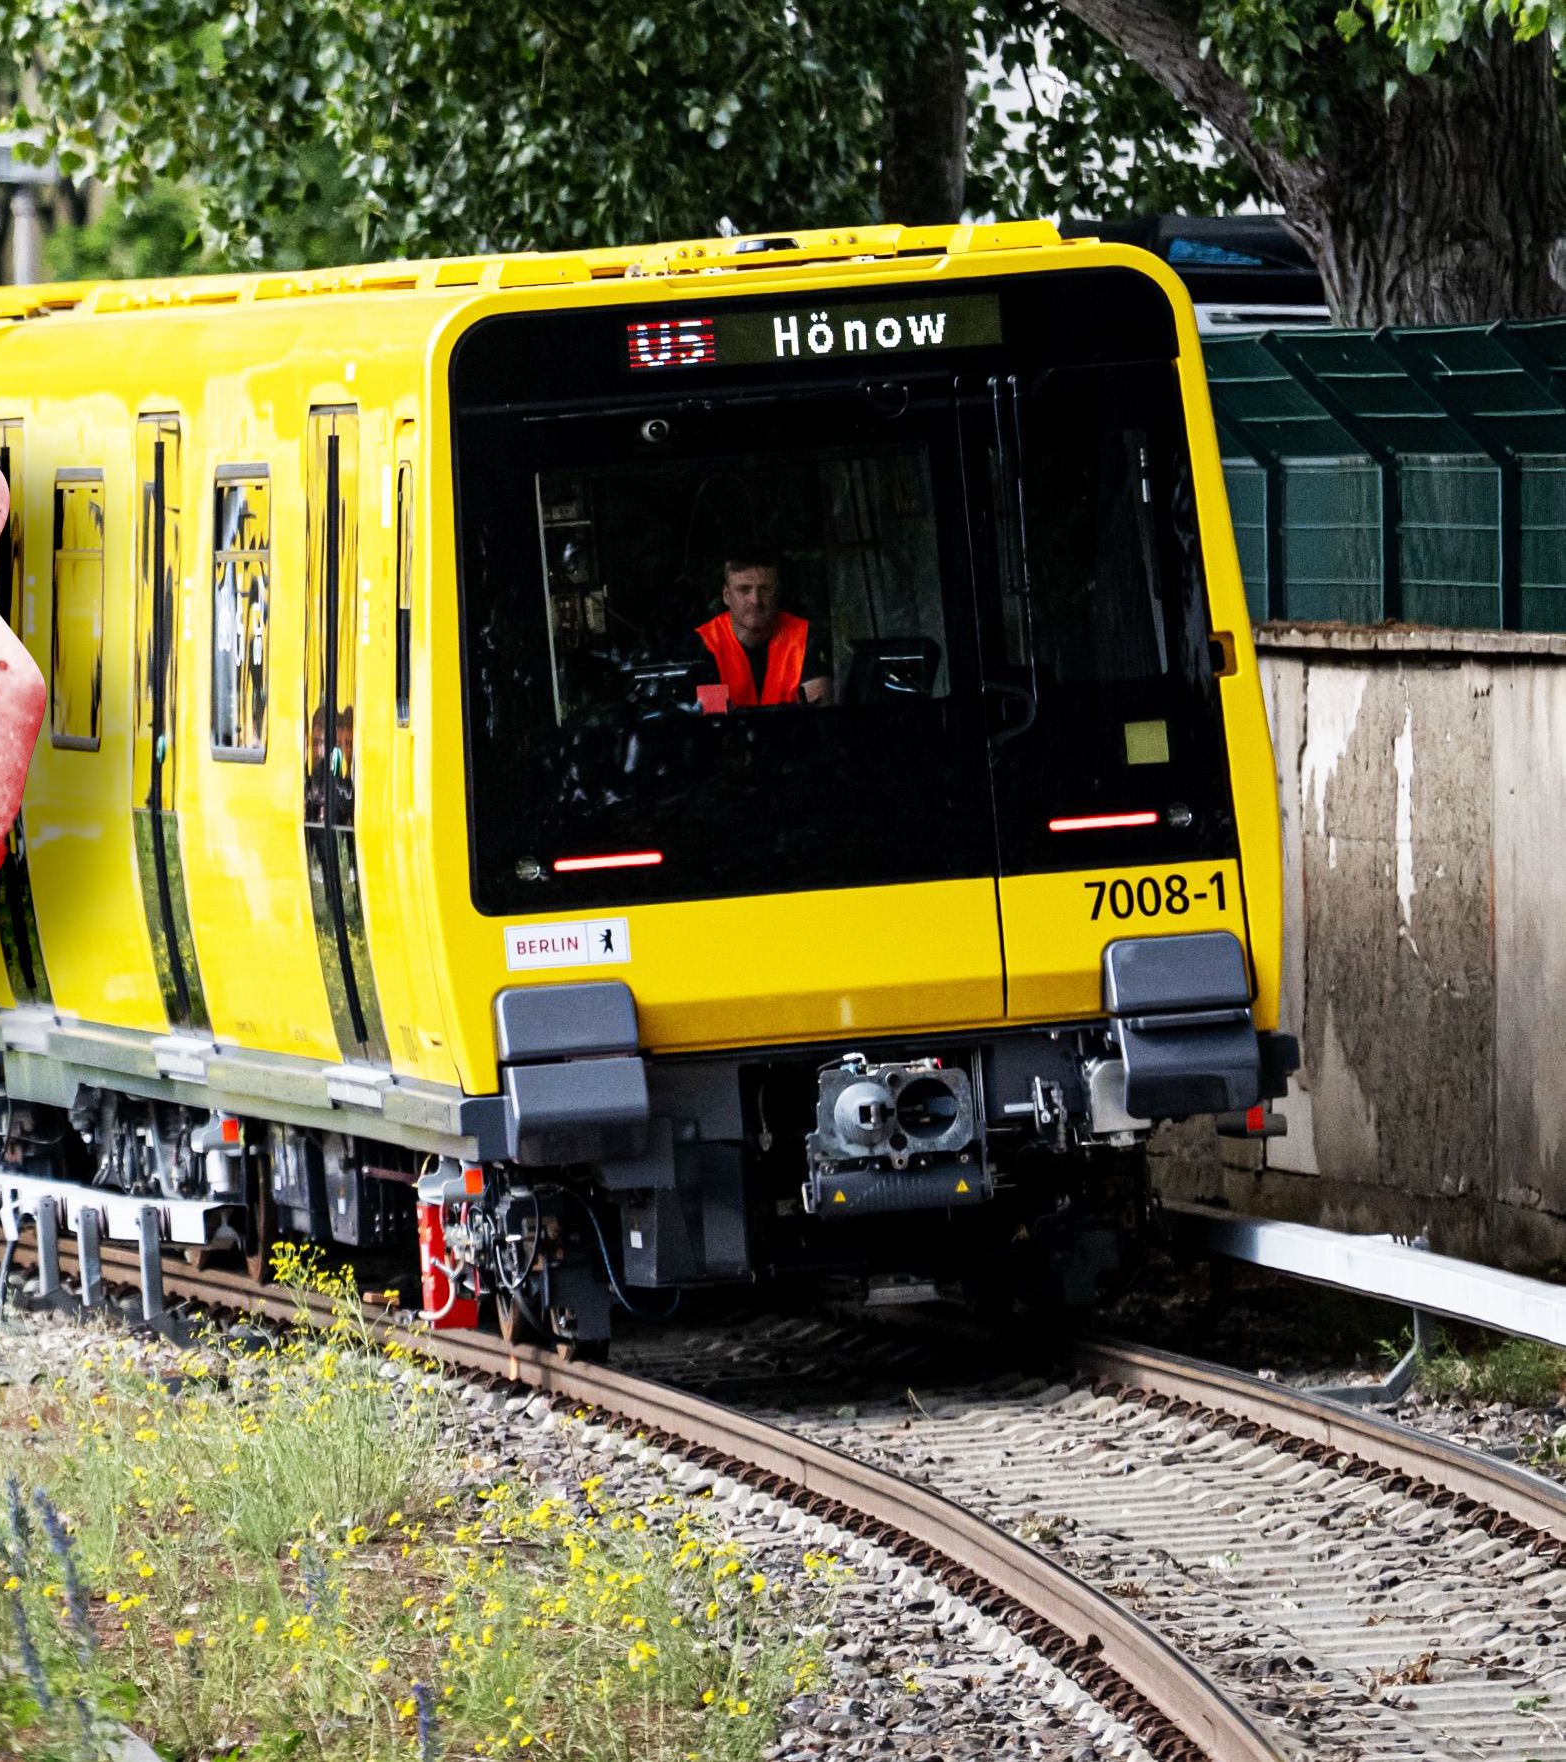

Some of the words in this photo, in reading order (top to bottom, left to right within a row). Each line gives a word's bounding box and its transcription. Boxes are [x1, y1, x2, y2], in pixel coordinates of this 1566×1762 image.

[636, 320, 705, 367] U5
[772, 311, 947, 358] Hönow
[1083, 870, 1227, 921] 7008-1
[516, 936, 579, 956] BERLIN
